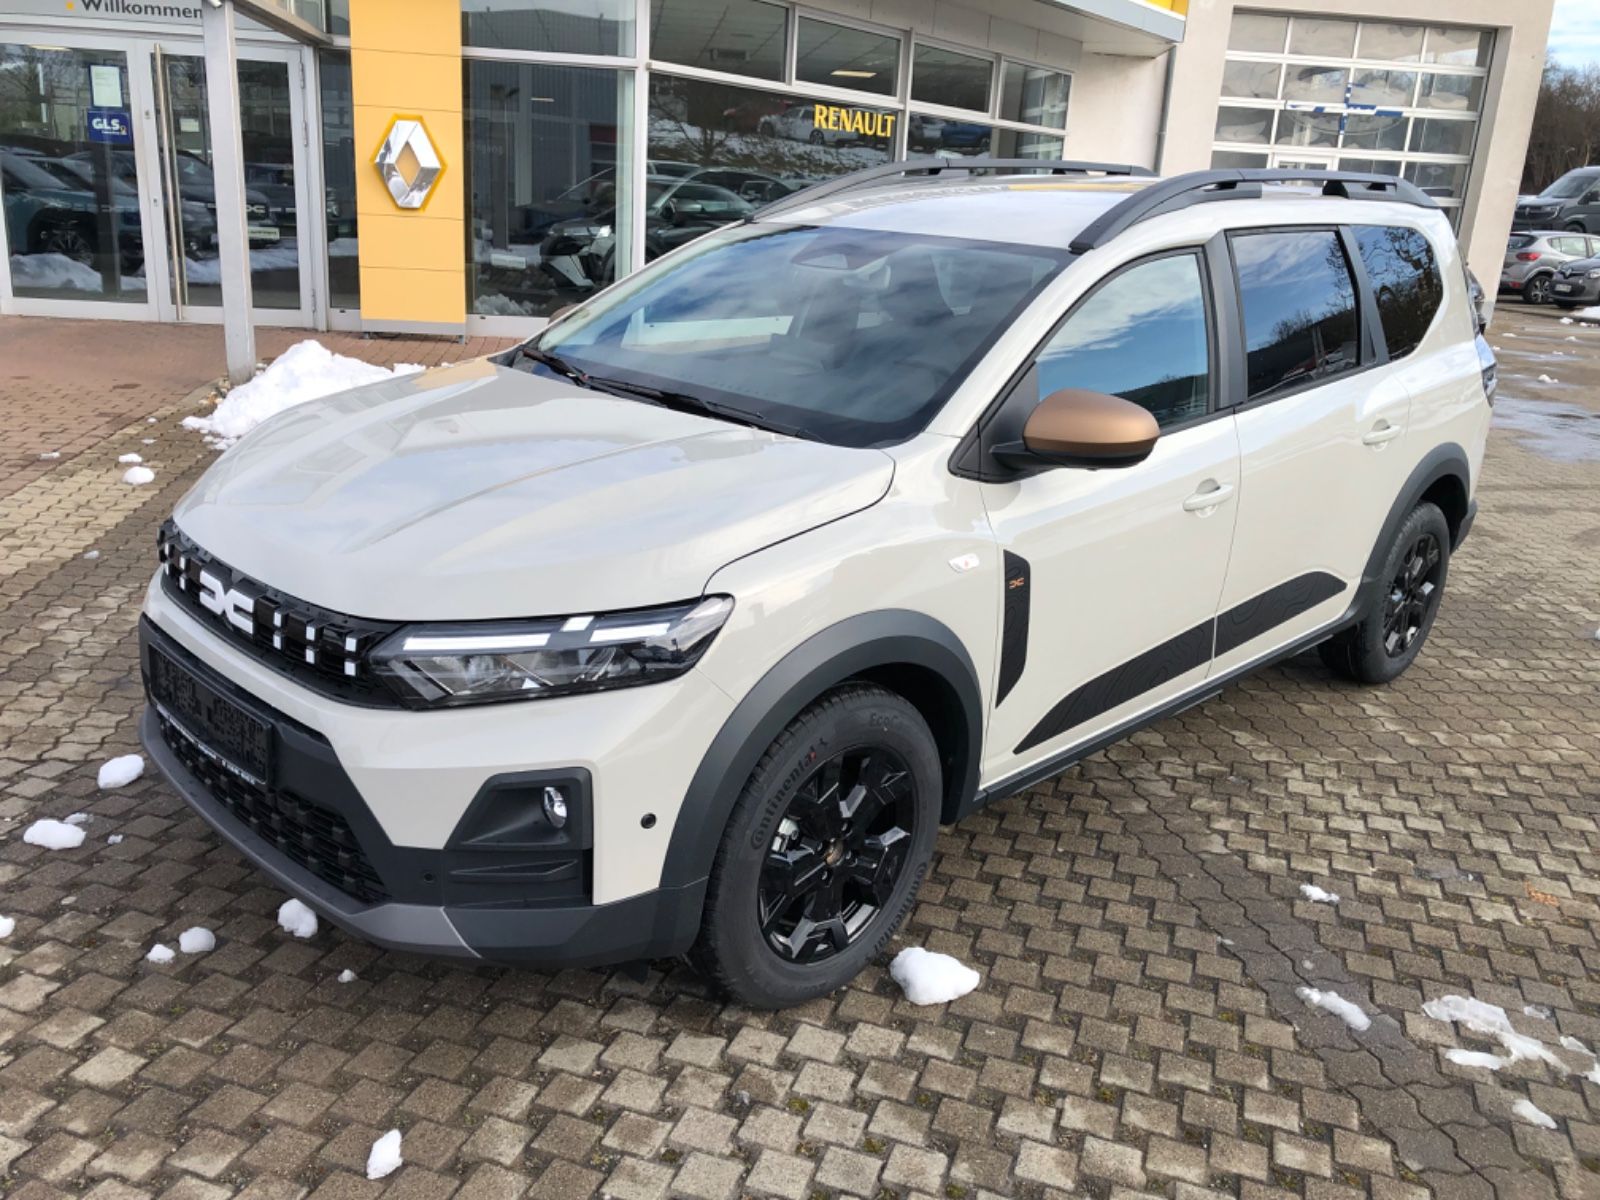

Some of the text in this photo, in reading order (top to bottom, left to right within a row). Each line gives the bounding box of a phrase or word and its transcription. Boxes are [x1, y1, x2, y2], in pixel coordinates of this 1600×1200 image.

[81, 0, 203, 18] Willkommen
[91, 117, 120, 131] GLS
[813, 104, 896, 137] RENAULT
[752, 745, 818, 849] Continental
